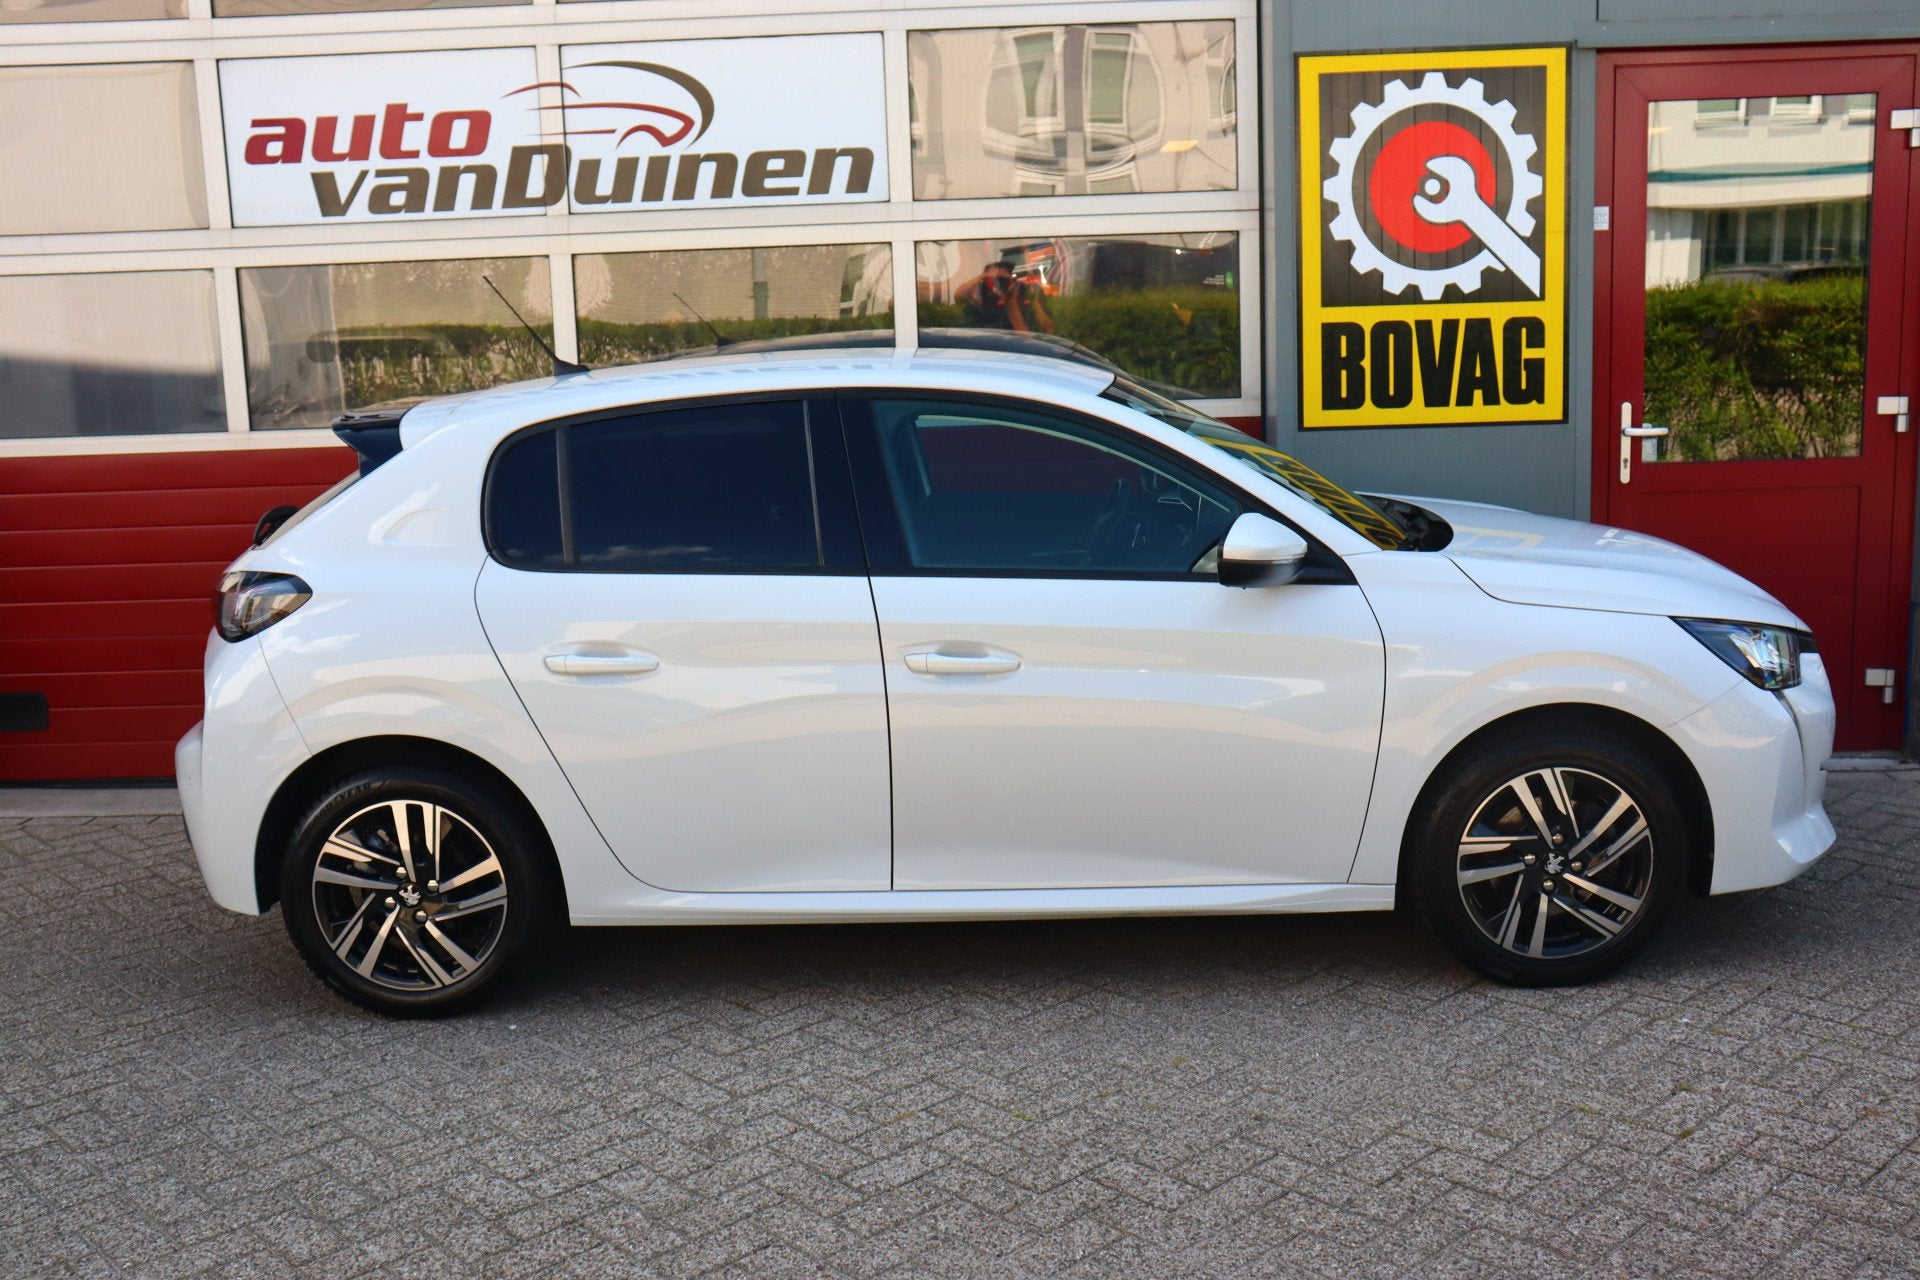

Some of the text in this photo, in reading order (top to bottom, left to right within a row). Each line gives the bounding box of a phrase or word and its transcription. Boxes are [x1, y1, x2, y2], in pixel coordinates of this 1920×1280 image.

[244, 103, 492, 165] auto
[1321, 316, 1546, 411] BOVAG
[307, 781, 371, 830] OODYEAR
